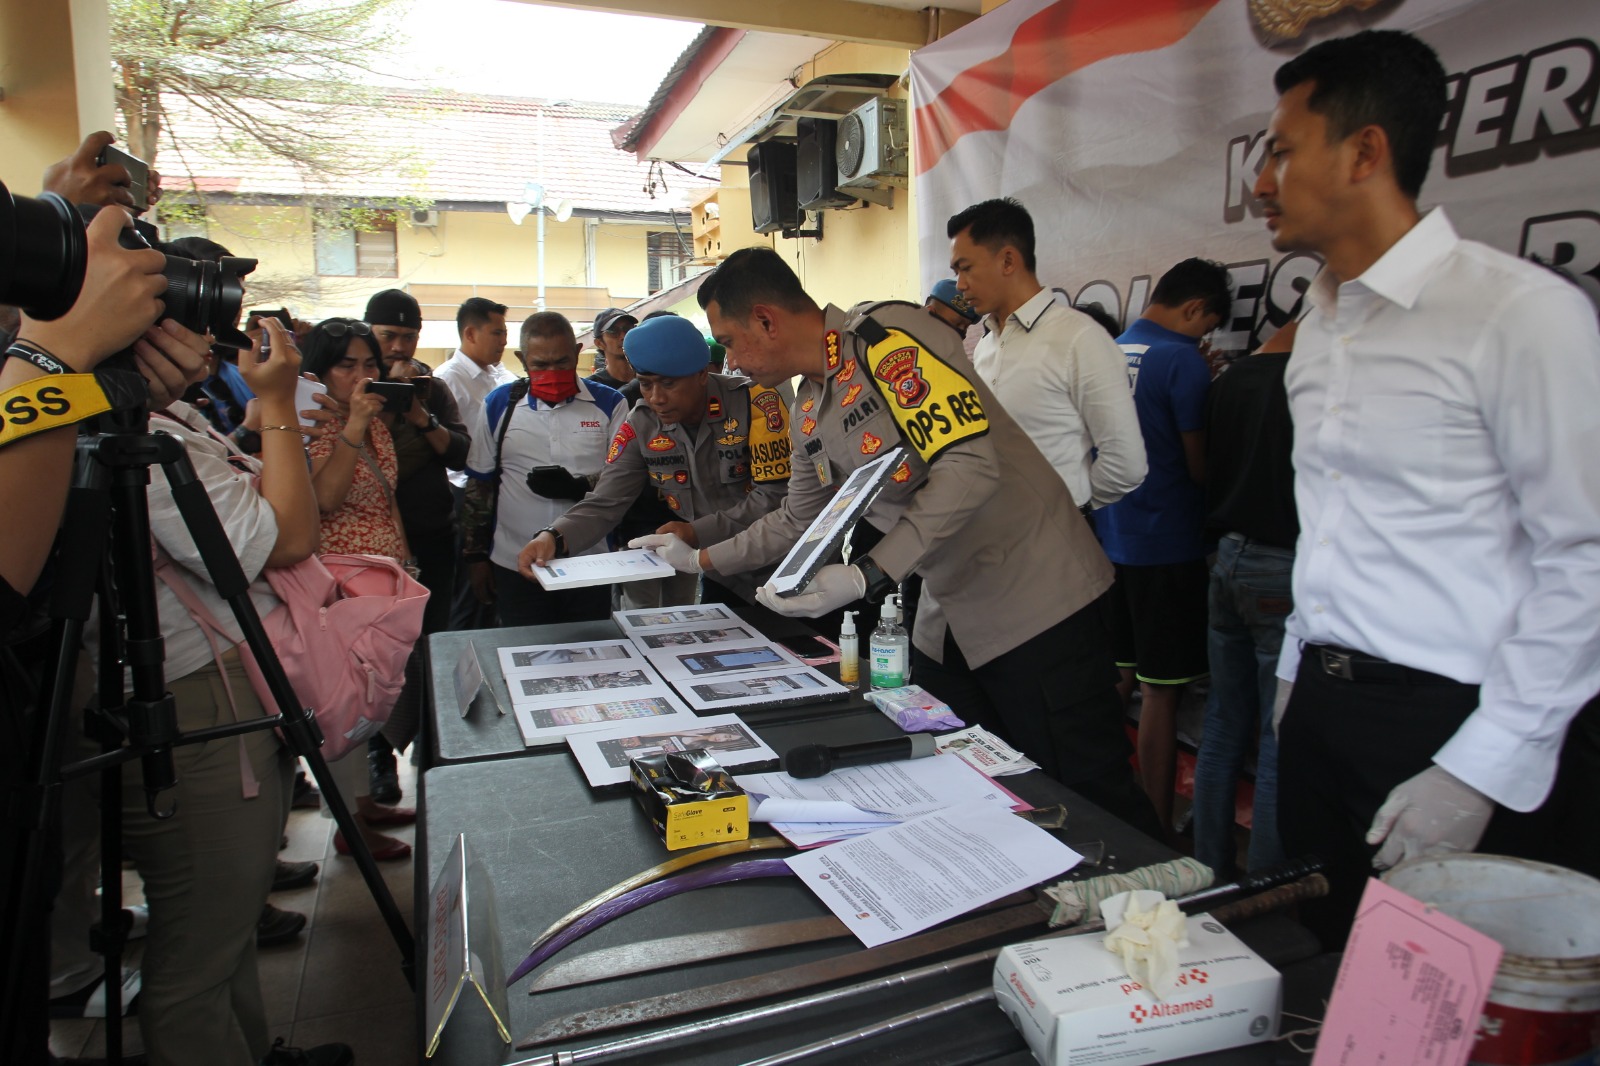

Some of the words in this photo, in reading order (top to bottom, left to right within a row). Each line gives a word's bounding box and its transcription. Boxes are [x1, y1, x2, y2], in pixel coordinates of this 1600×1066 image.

[0, 386, 71, 433] SS
[843, 396, 879, 433] POLRI
[906, 402, 952, 451] OPS
[1024, 957, 1041, 966] 100
[1057, 988, 1073, 996] Use
[1150, 995, 1214, 1018] Altamed
